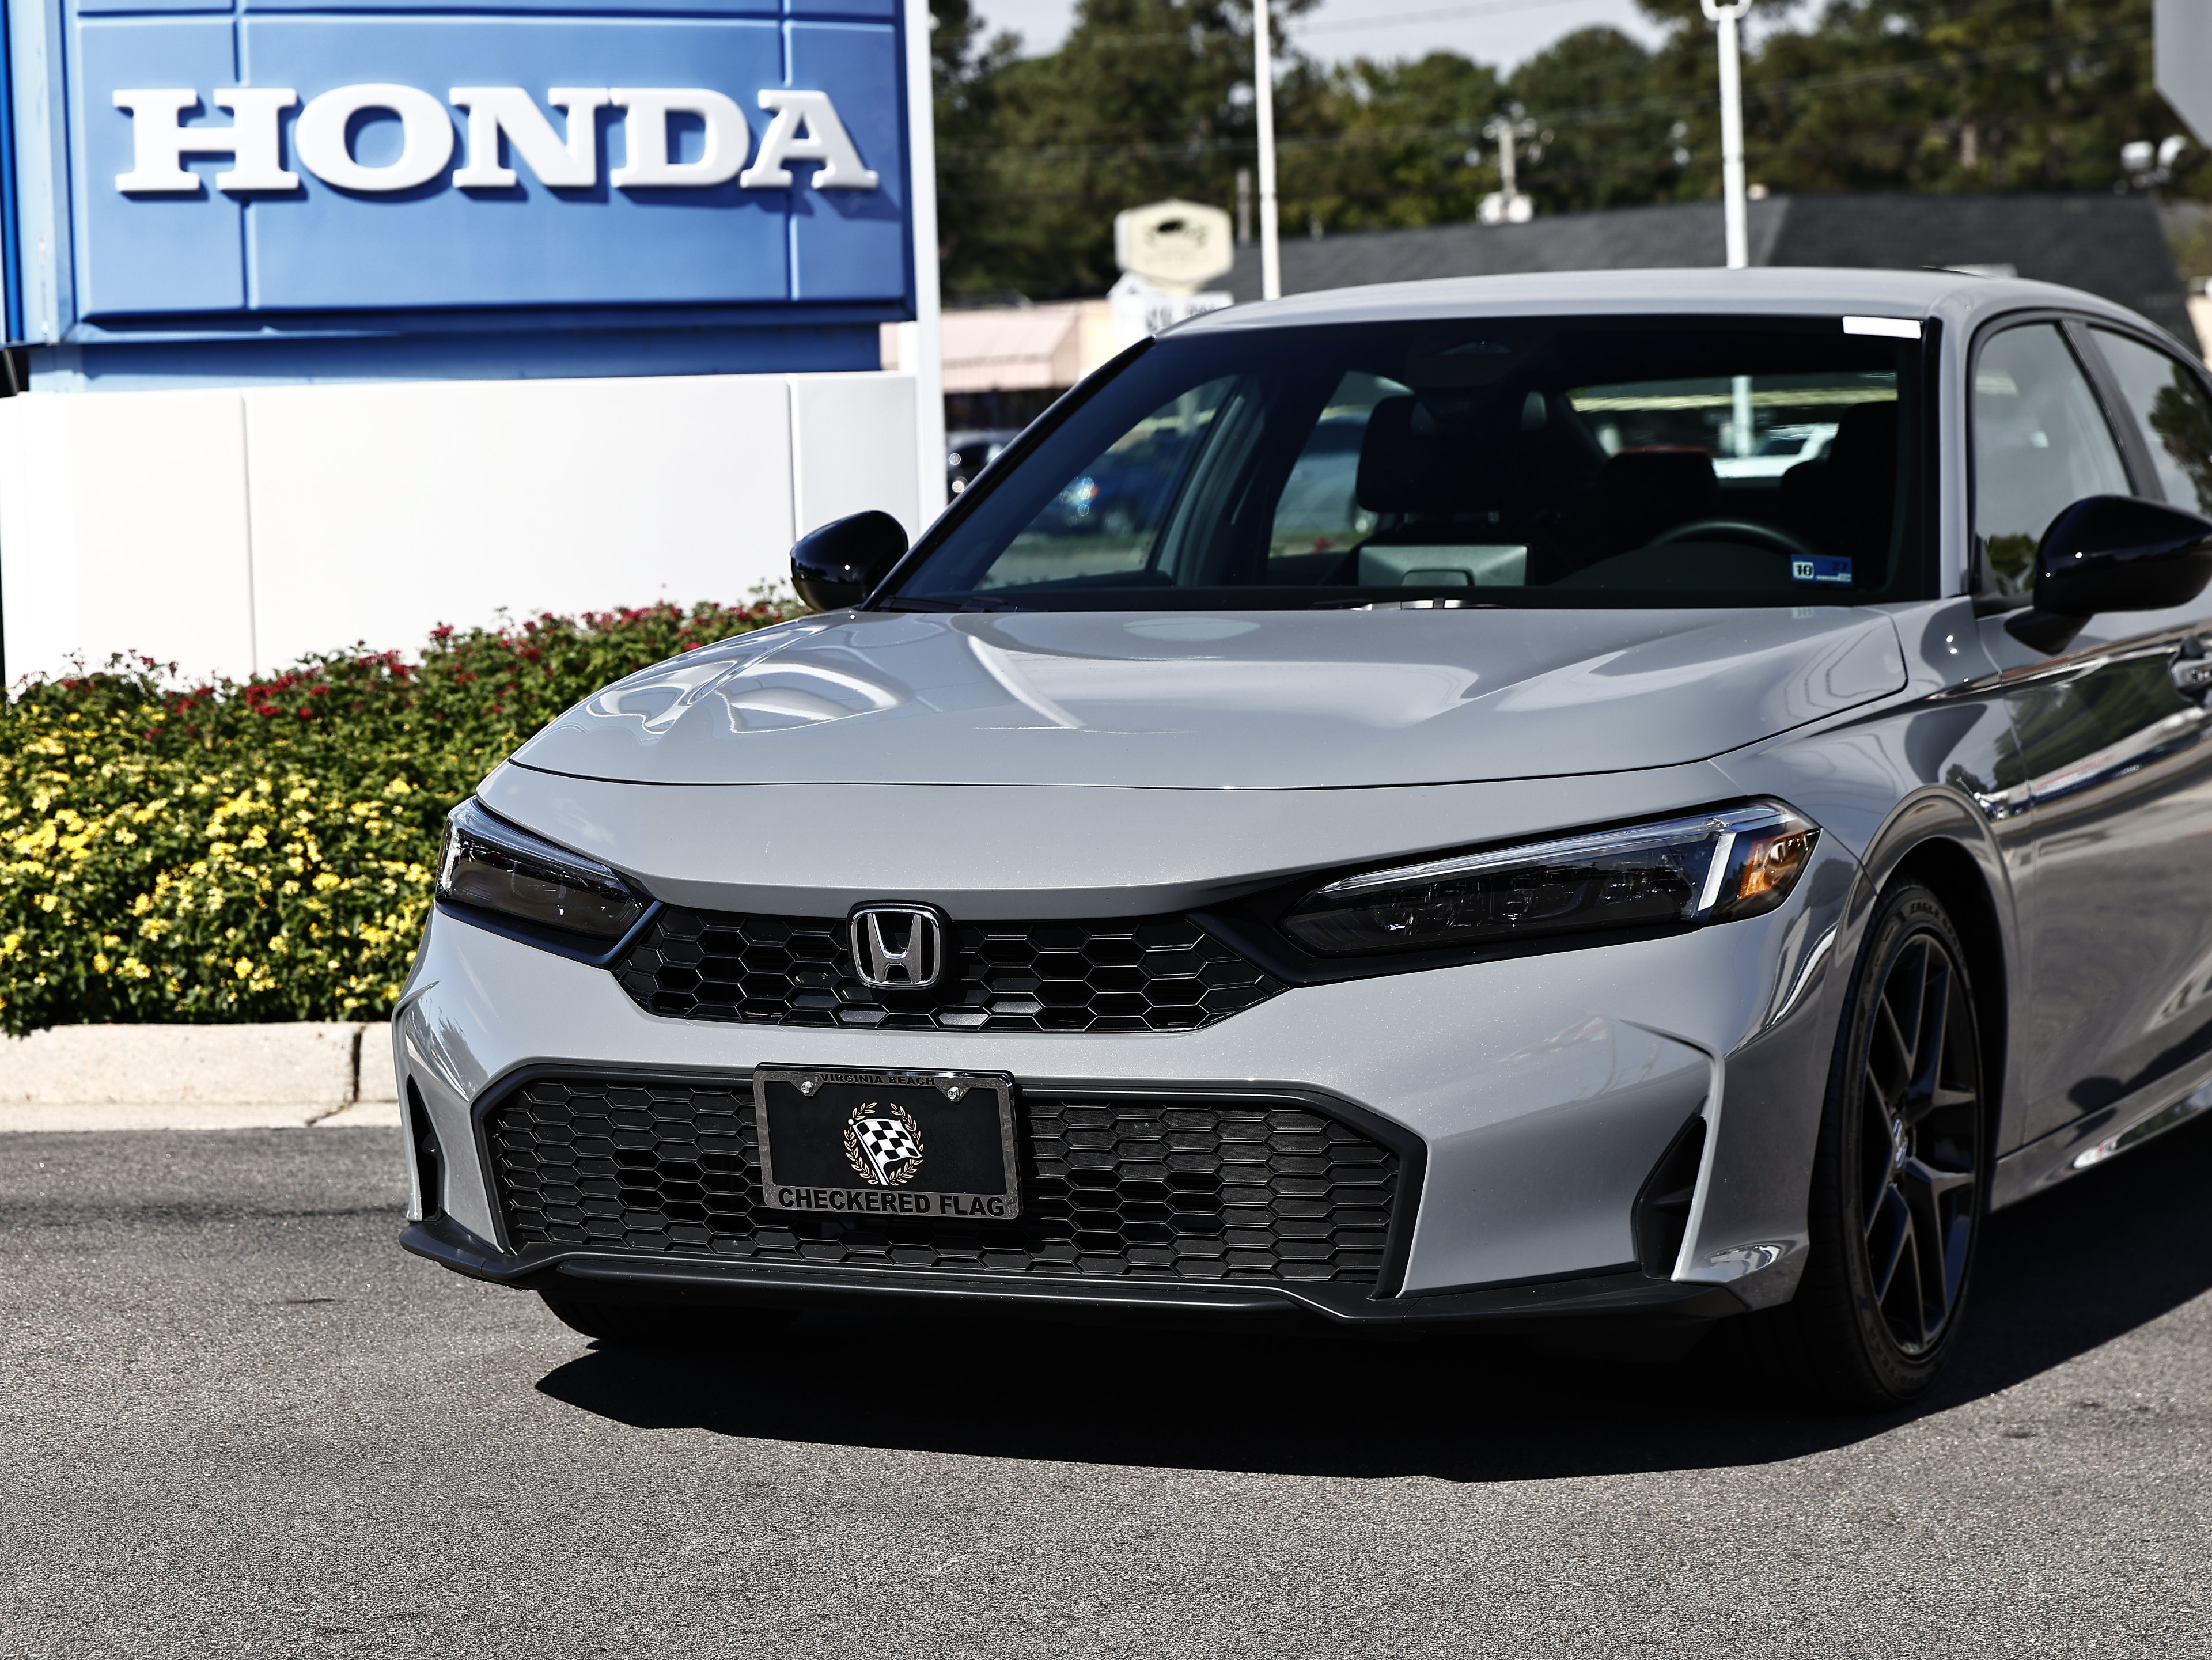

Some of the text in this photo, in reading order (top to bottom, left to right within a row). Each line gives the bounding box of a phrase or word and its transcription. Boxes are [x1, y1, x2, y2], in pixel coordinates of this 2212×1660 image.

[112, 84, 879, 191] HONDA
[1797, 564, 1812, 575] 10
[820, 1073, 935, 1085] VIRGINIA BEACH
[778, 1188, 1004, 1217] CHECKERED FLAG
